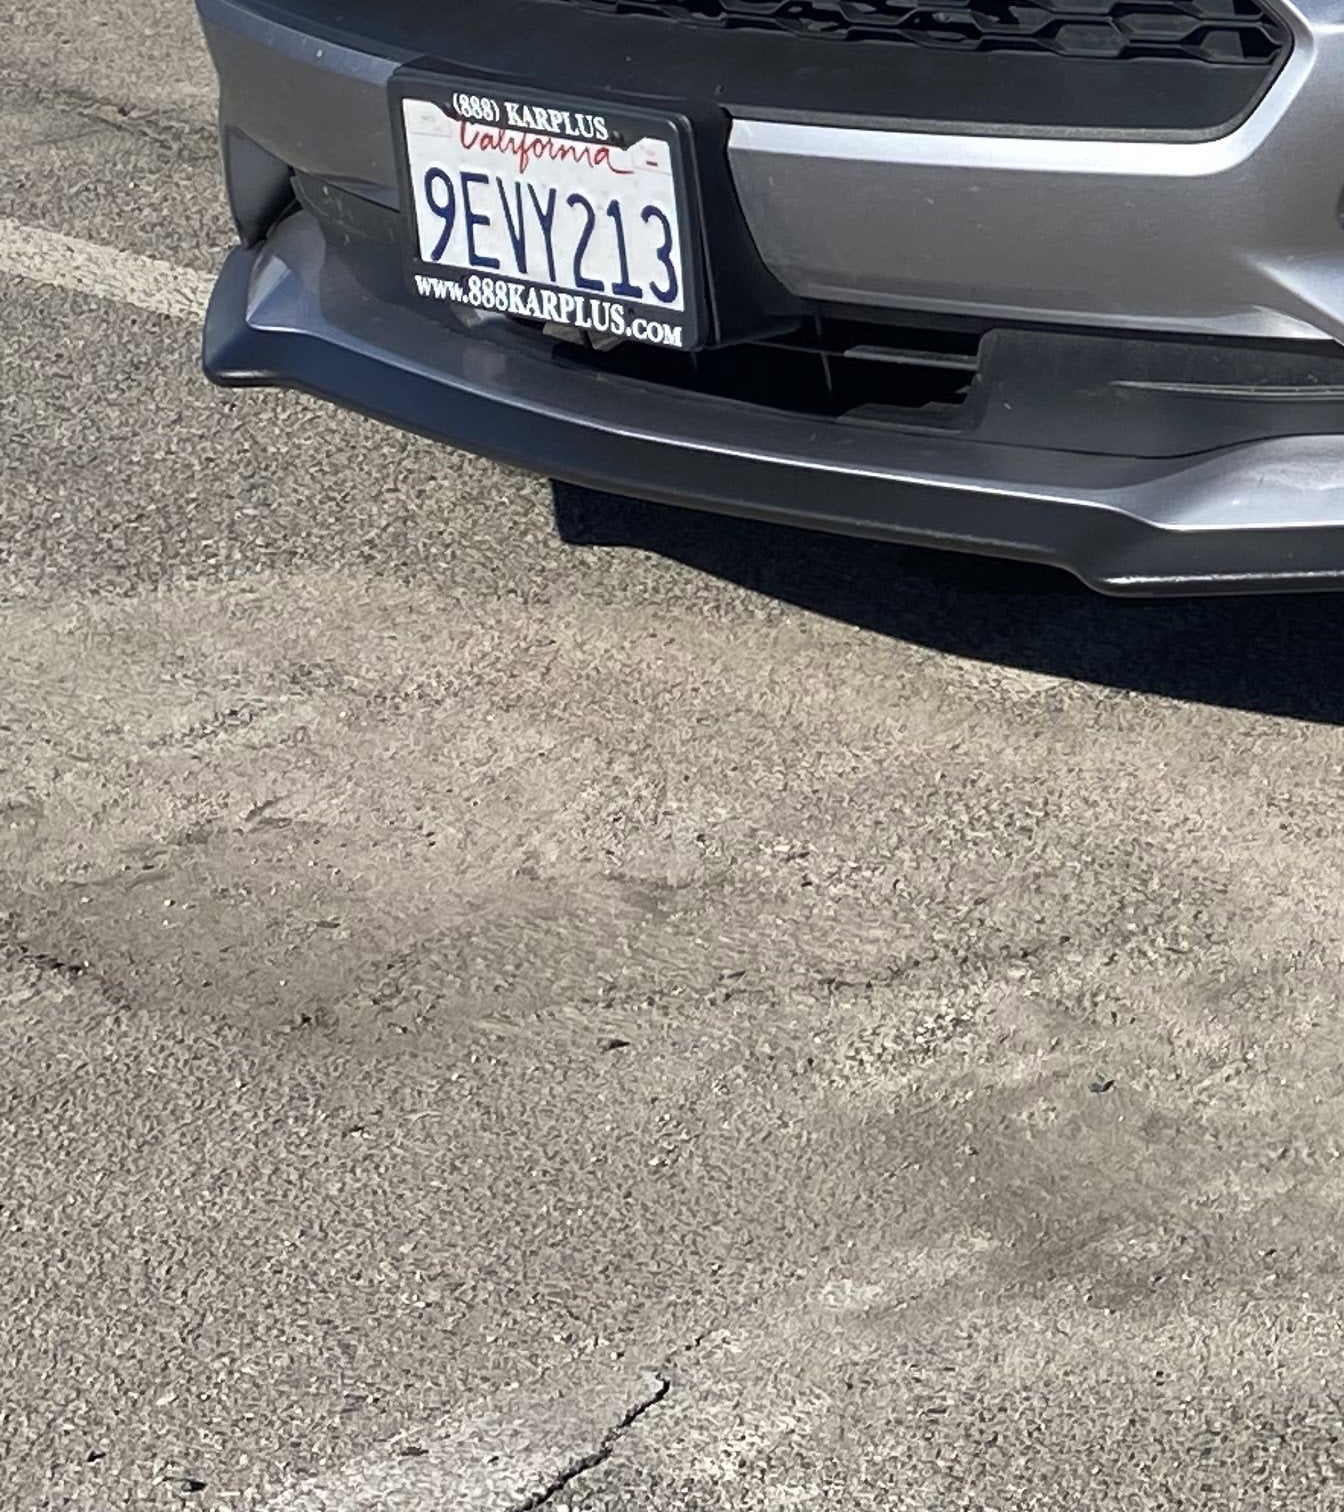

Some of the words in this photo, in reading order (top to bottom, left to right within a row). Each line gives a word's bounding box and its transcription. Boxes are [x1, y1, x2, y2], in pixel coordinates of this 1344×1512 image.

[452, 92, 500, 122] (888)
[504, 101, 609, 140] KARPLUS
[459, 122, 634, 174] California
[424, 167, 678, 303] 9EVY213
